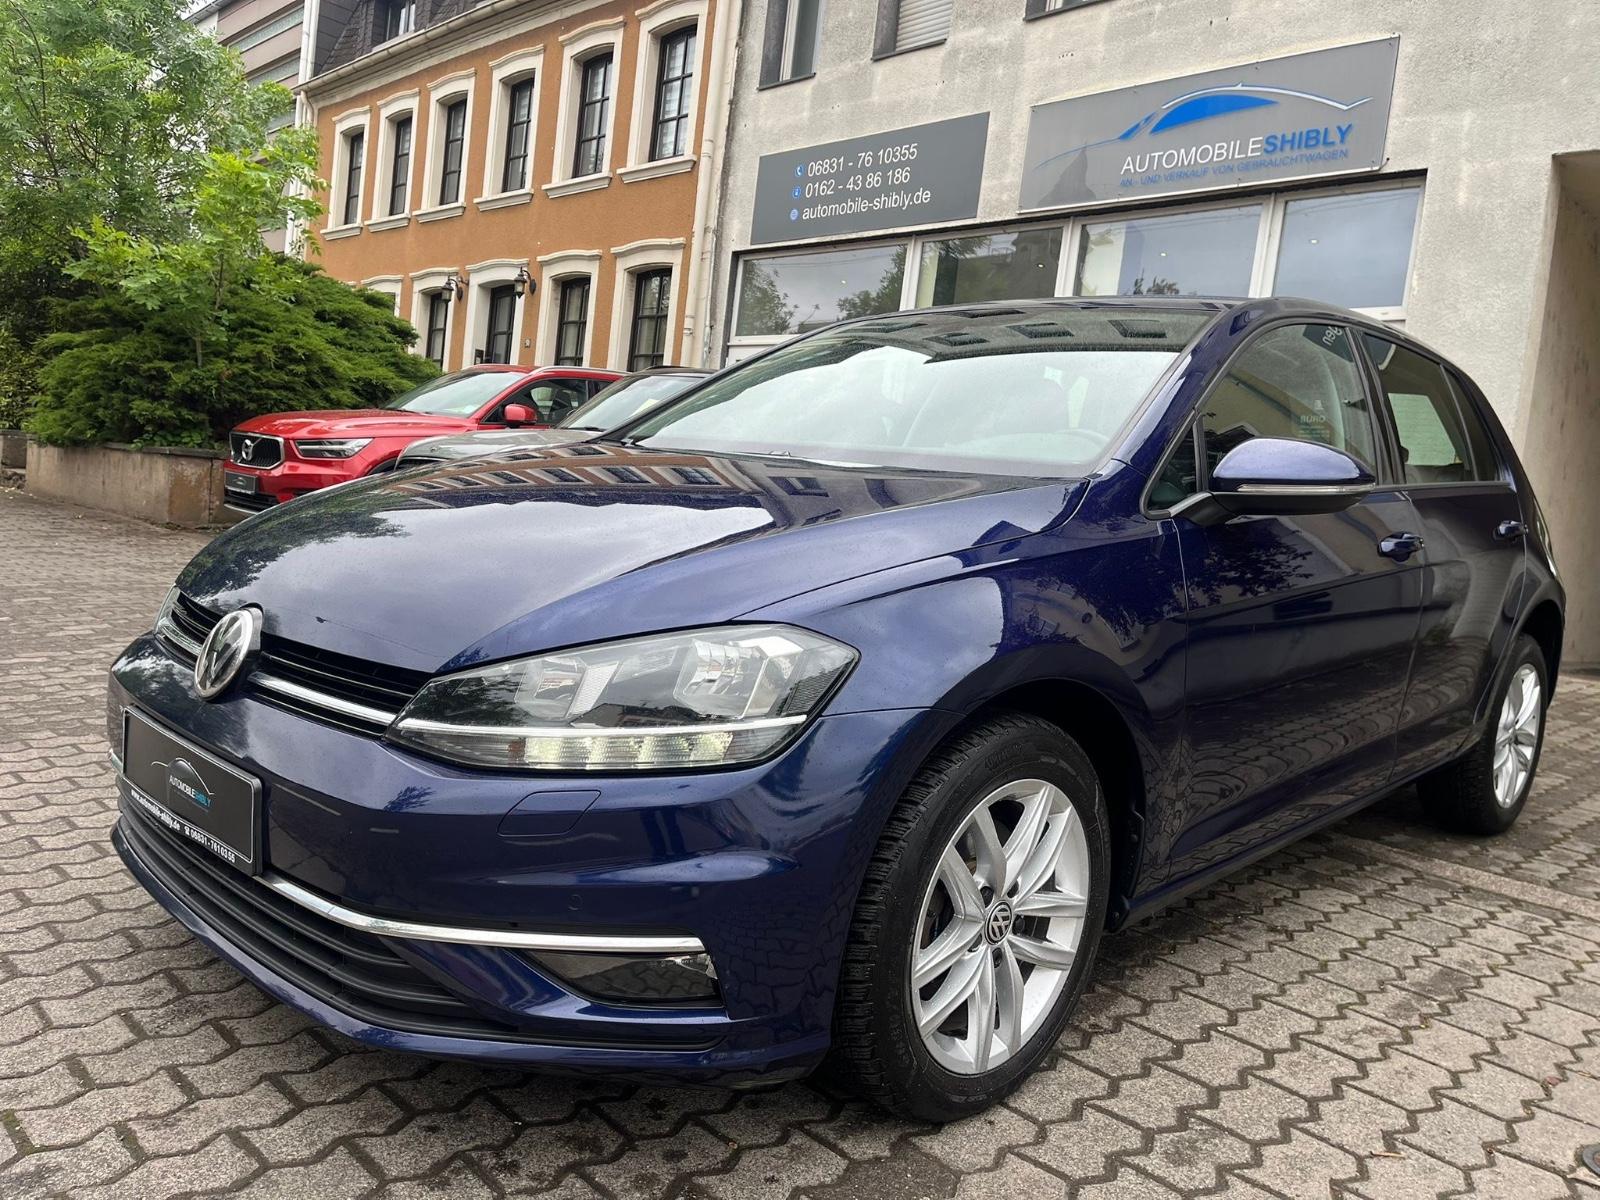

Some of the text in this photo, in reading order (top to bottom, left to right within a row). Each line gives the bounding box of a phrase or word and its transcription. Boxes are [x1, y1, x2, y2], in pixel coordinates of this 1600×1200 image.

[807, 156, 844, 177] 06831
[857, 151, 873, 169] 76
[877, 143, 919, 165] 10355
[1140, 174, 1160, 185] UND
[1163, 166, 1209, 182] VERKAUF
[1212, 163, 1234, 176] VON
[1237, 149, 1350, 172] GEBRAUCHTWAGEN
[805, 180, 836, 198] 0162
[846, 175, 862, 192] 43
[866, 172, 882, 189] 86
[887, 166, 911, 184] 186
[802, 187, 931, 220] automobile-shibly.de
